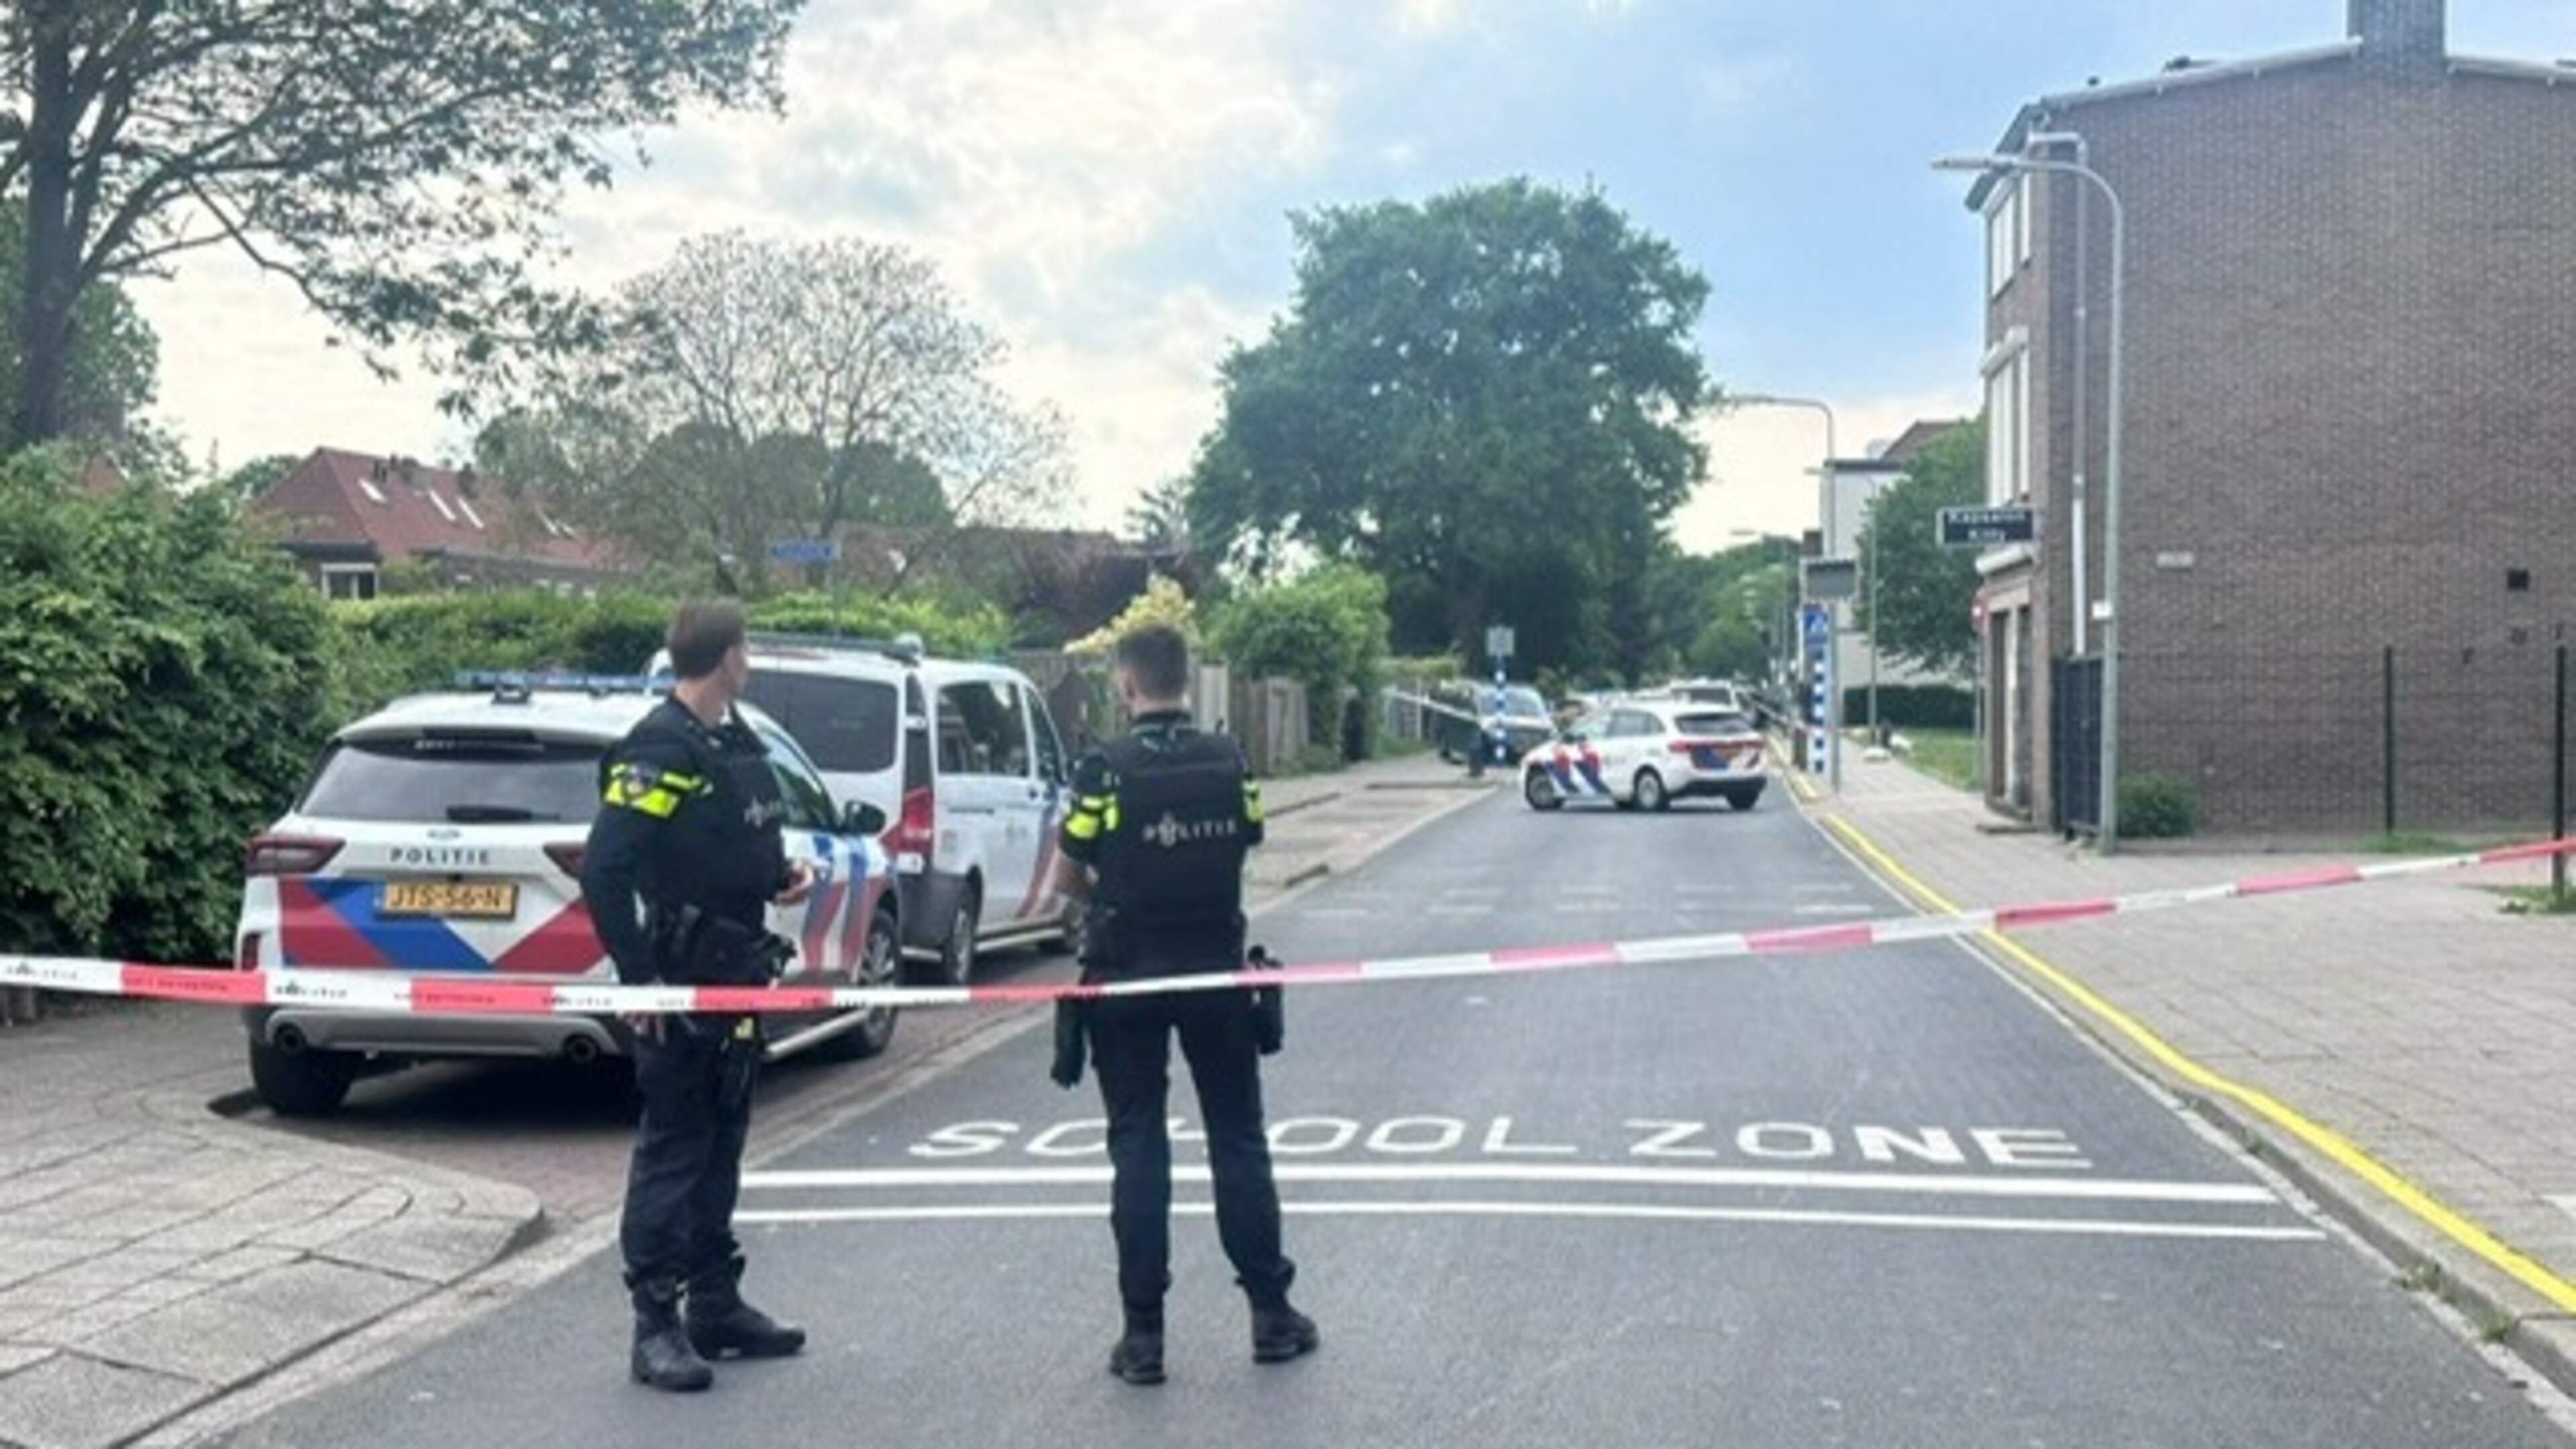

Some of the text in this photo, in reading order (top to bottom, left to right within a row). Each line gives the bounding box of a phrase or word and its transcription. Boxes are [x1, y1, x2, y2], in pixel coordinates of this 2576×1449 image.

[390, 847, 488, 865] POLITIE
[390, 885, 501, 909] JTS-56-N
[1623, 1118, 2094, 1169] ZONE
